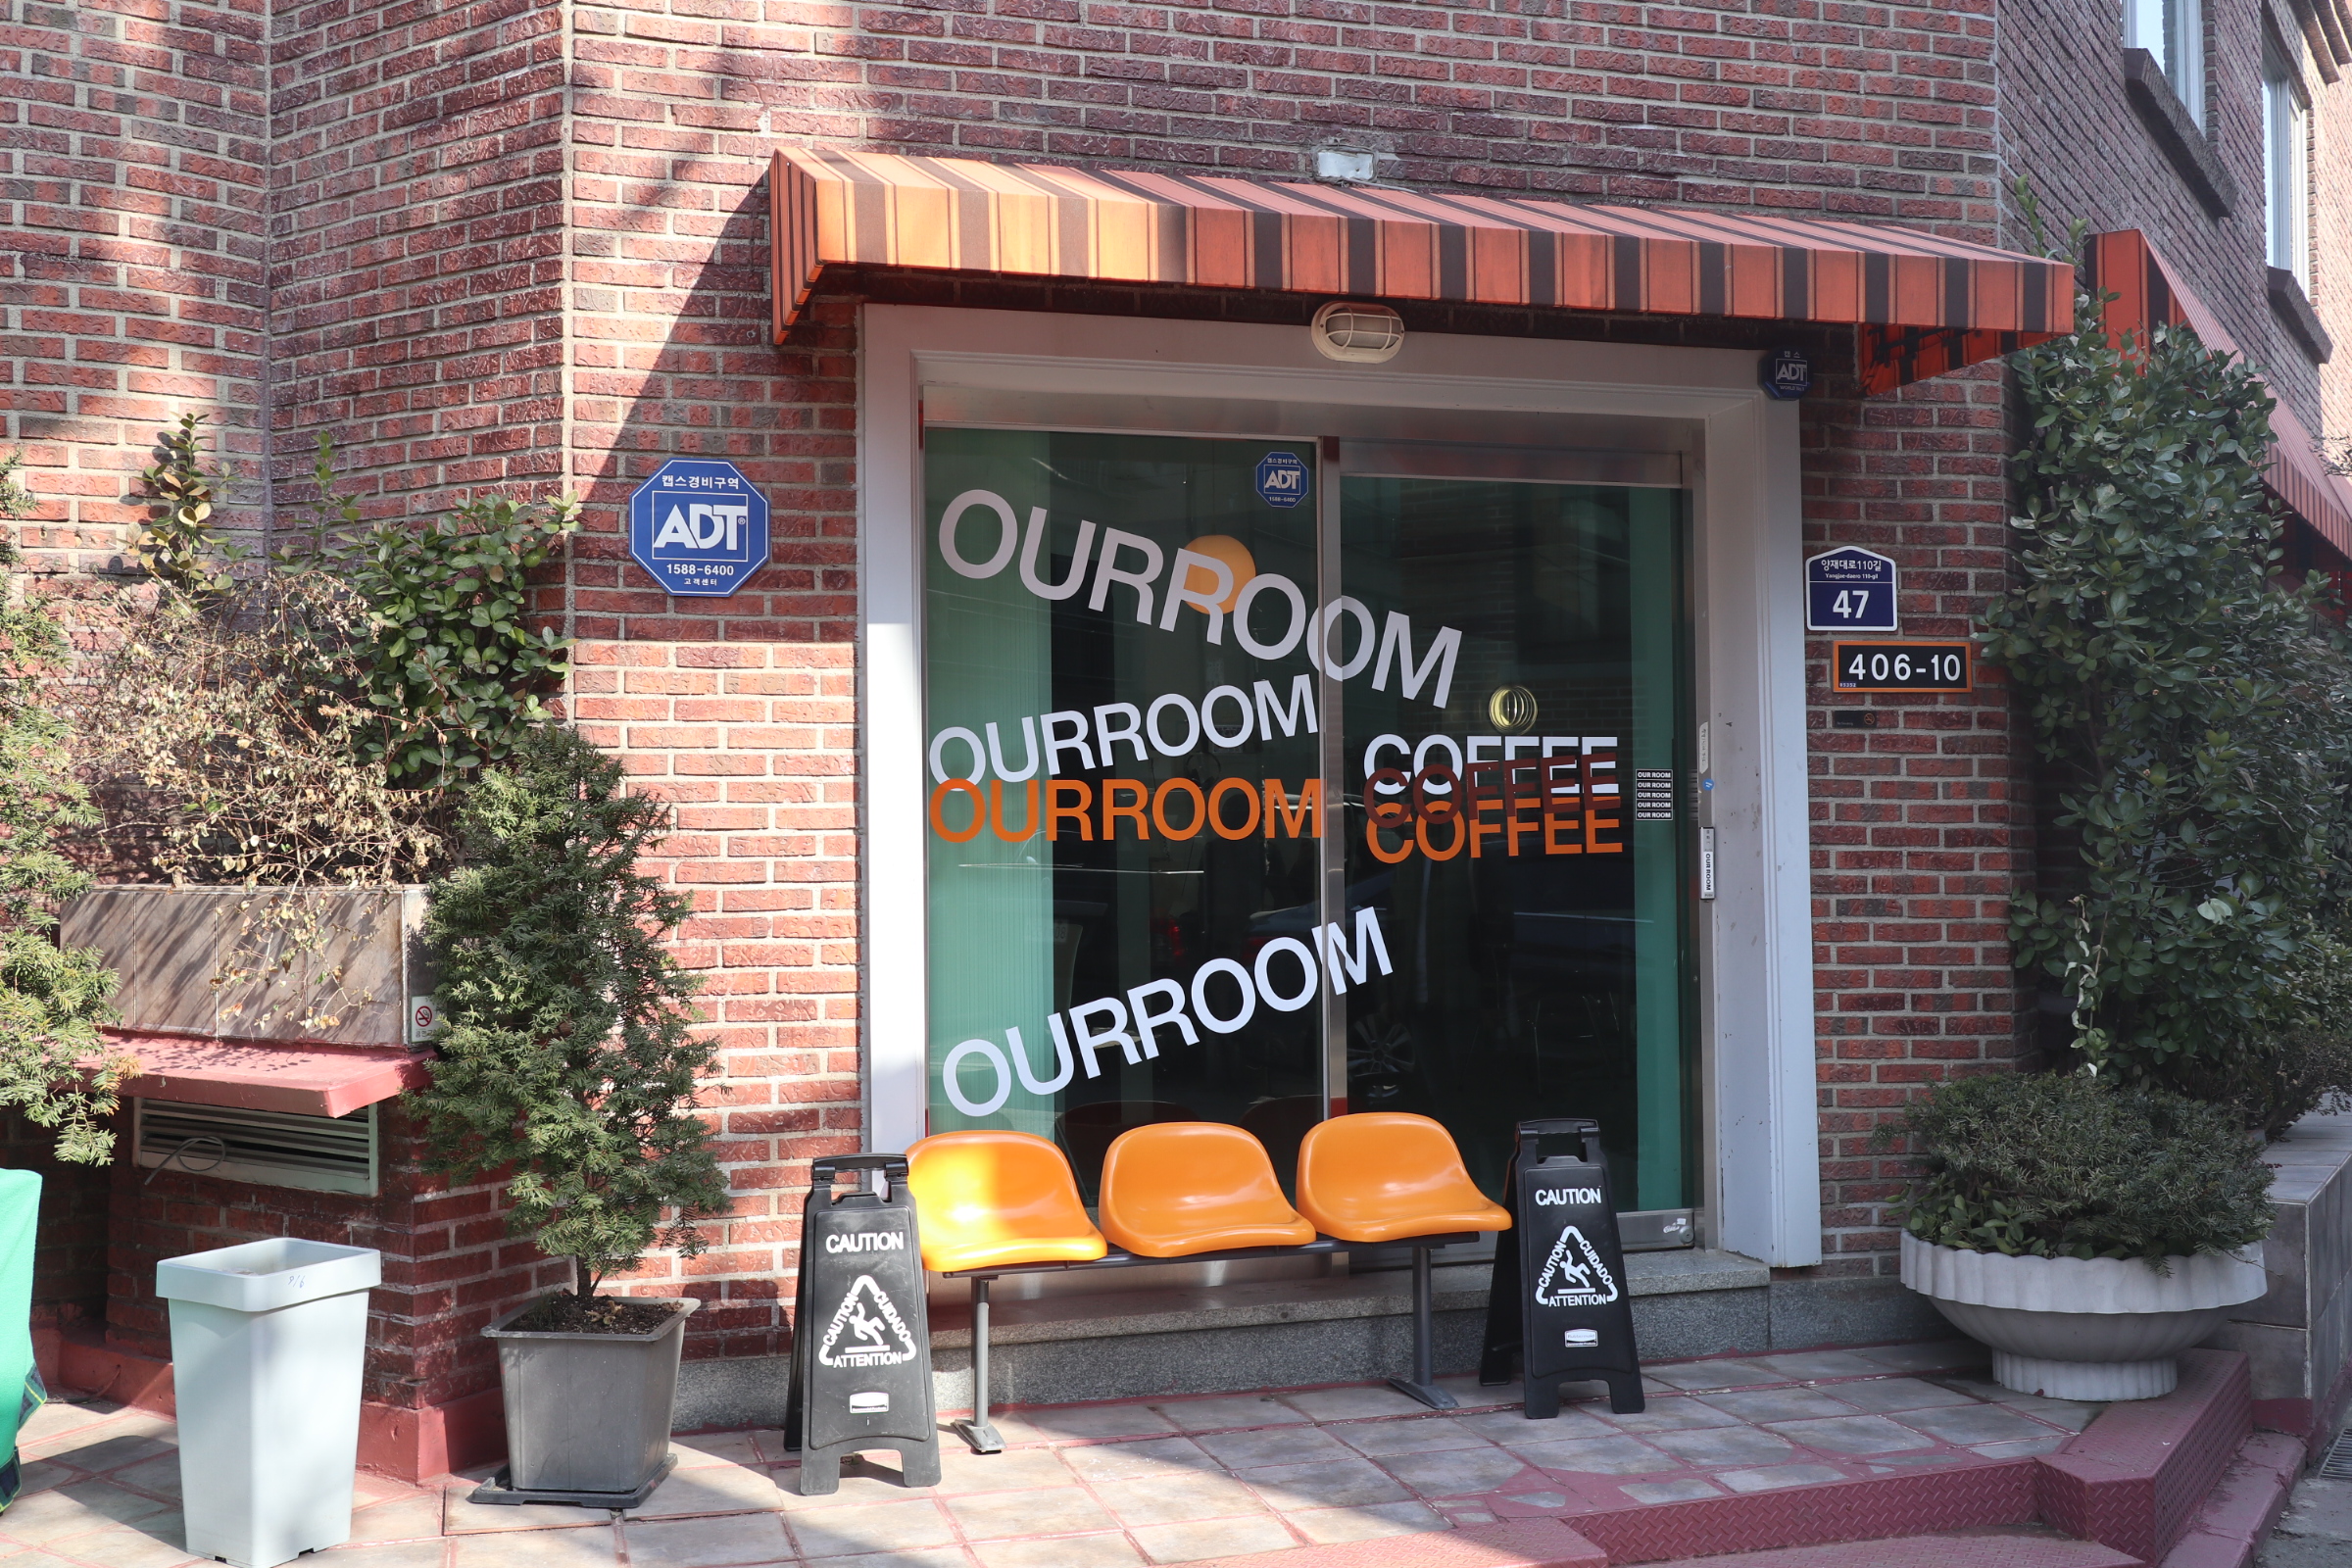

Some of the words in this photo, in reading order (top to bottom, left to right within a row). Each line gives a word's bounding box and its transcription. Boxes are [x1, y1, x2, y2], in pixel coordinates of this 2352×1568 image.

[1776, 363, 1807, 381] ADT
[662, 474, 739, 489] 캡스경비구역
[1264, 469, 1300, 489] ADT
[654, 503, 748, 550] ADT
[666, 564, 734, 576] 1588-6400
[1821, 559, 1882, 572] 양재대로110길
[684, 577, 717, 586] 고객센터
[938, 489, 1463, 709] OURROOM
[1833, 590, 1869, 618] 47
[1848, 653, 1961, 681] 406-10
[929, 673, 1319, 791] OURROOM
[929, 777, 1323, 843] OURROOM
[1366, 796, 1623, 863] COFFEE
[943, 906, 1394, 1117] OURROOM
[1535, 1187, 1602, 1206] CAUTION
[825, 1231, 904, 1254] CAUTION
[1538, 1241, 1567, 1289] CAUTION
[1579, 1240, 1612, 1286] CUIDADO
[1548, 1294, 1607, 1307] ATTENTION
[823, 1292, 859, 1347] CAUTION
[873, 1290, 911, 1344] CUIDADO
[833, 1350, 902, 1369] ATTENTION
